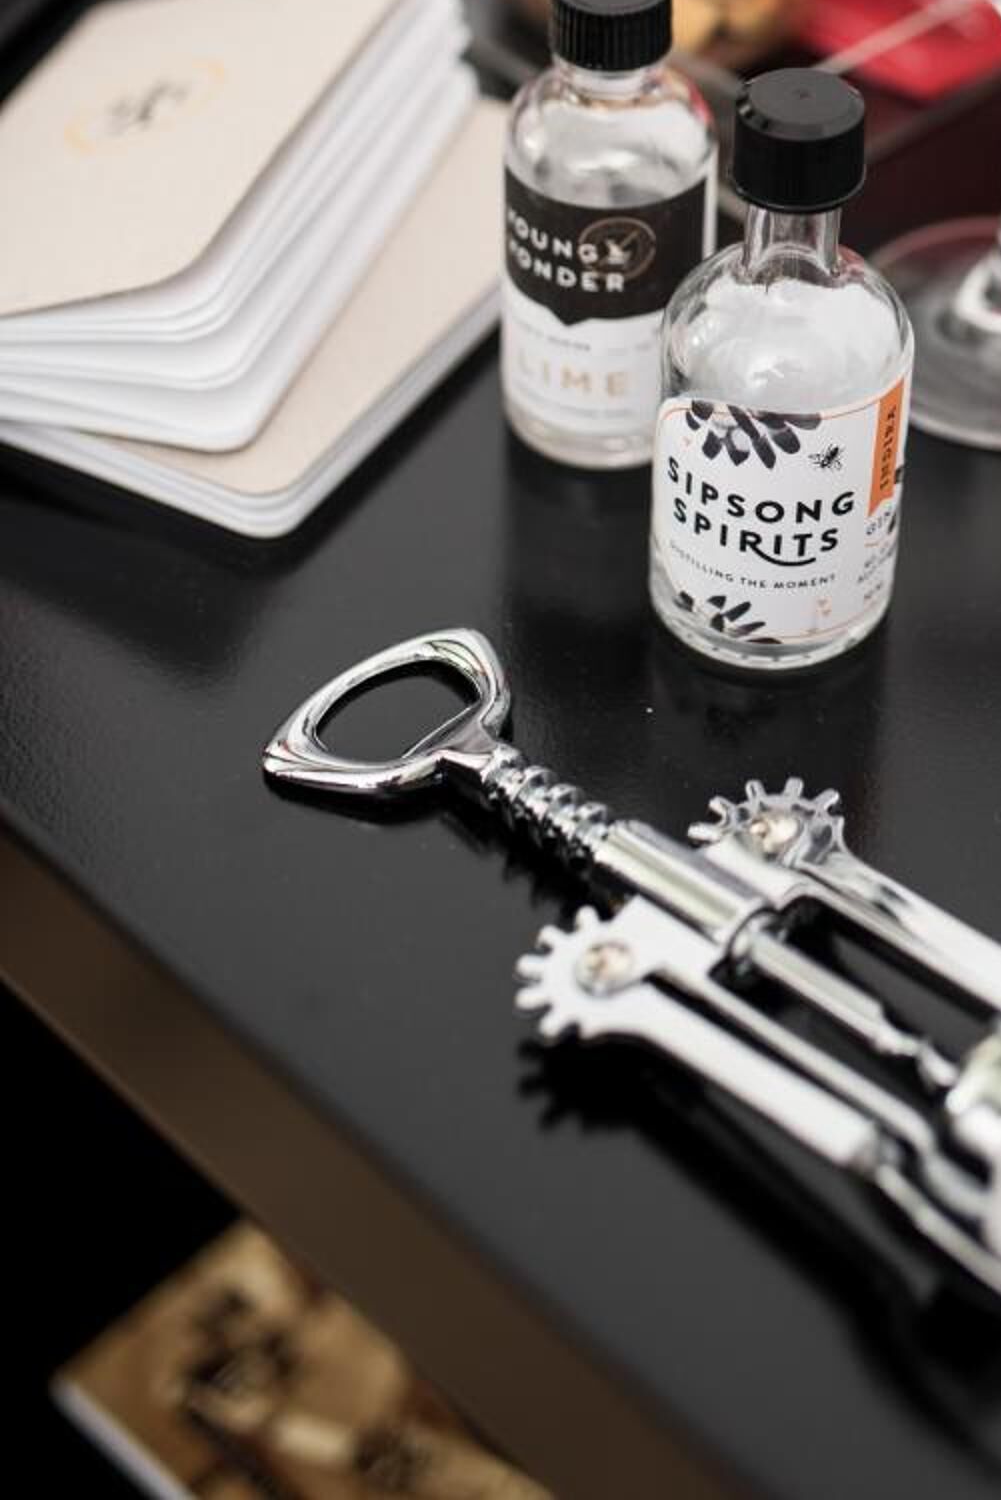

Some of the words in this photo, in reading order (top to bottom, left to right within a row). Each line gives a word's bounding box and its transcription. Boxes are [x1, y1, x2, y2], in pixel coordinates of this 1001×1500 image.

[517, 349, 625, 398] LIME
[667, 456, 855, 524] SIPSONG
[673, 497, 839, 567] SPIRITS
[740, 576, 767, 589] THE
[773, 573, 836, 590] MOMENT
